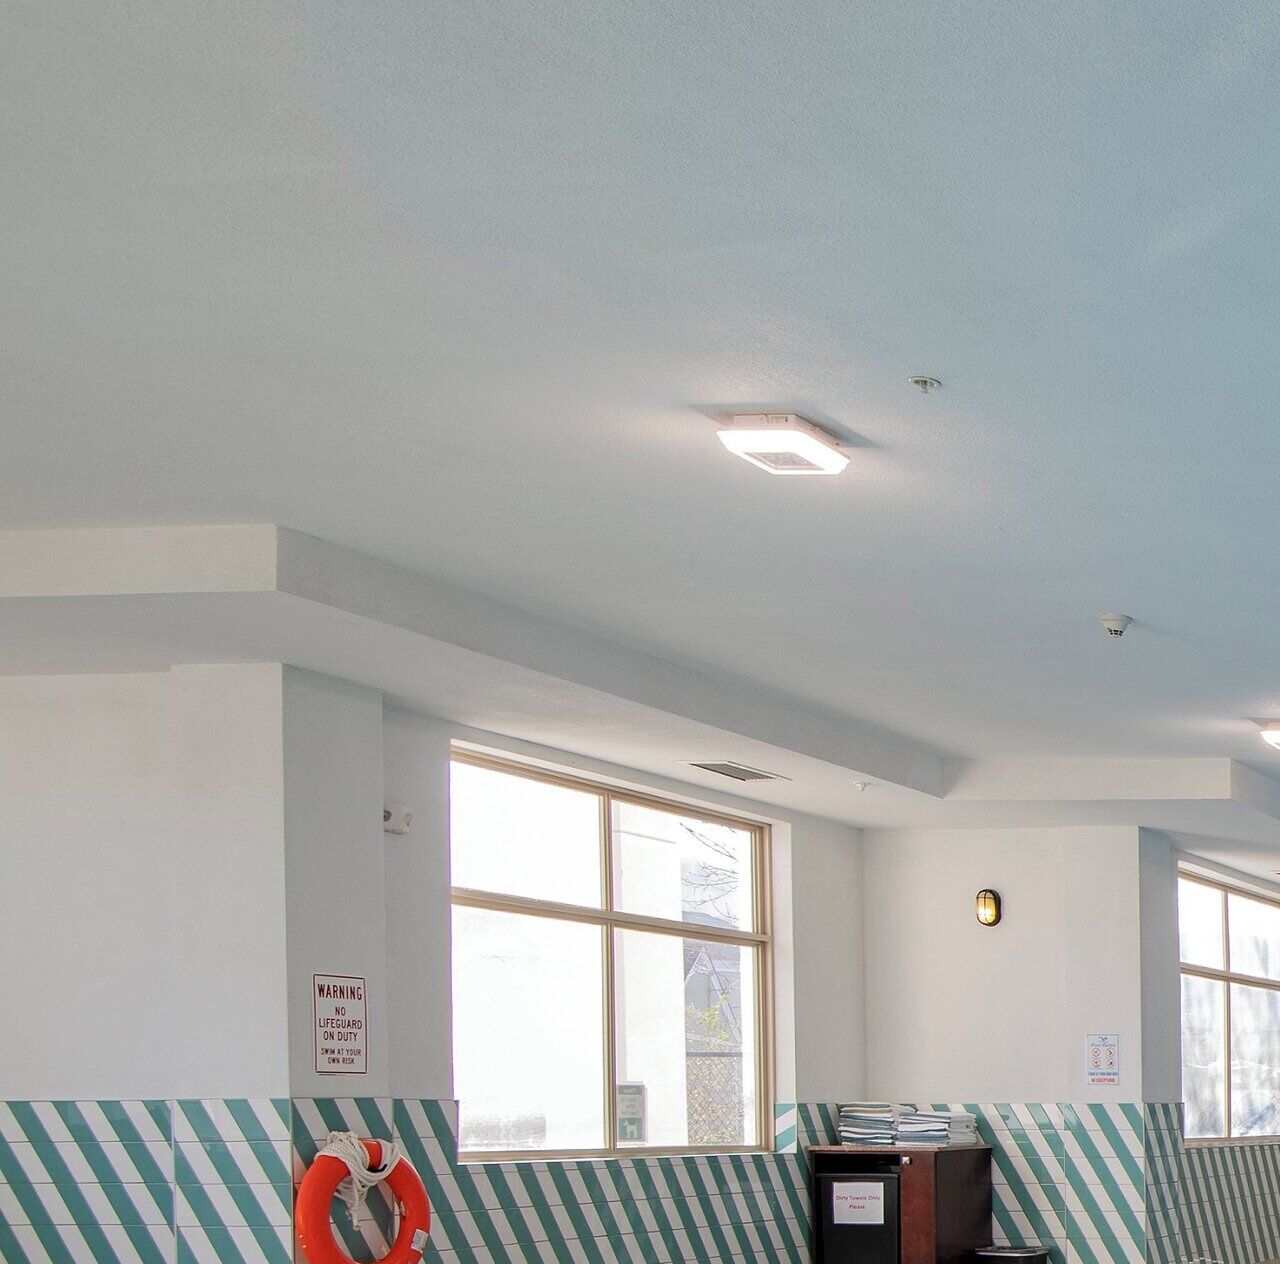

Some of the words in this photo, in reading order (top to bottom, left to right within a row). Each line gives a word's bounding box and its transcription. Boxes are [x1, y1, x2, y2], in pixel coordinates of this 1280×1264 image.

[317, 983, 363, 1000] WARNING
[335, 1006, 346, 1016] NO
[319, 1018, 363, 1029] LIFEGUARD
[323, 1030, 335, 1041] ON
[337, 1031, 358, 1042] DUTY
[321, 1048, 336, 1056] SWIM
[337, 1048, 344, 1056] AT
[345, 1048, 361, 1056] YOUR
[342, 1057, 355, 1065] RISK
